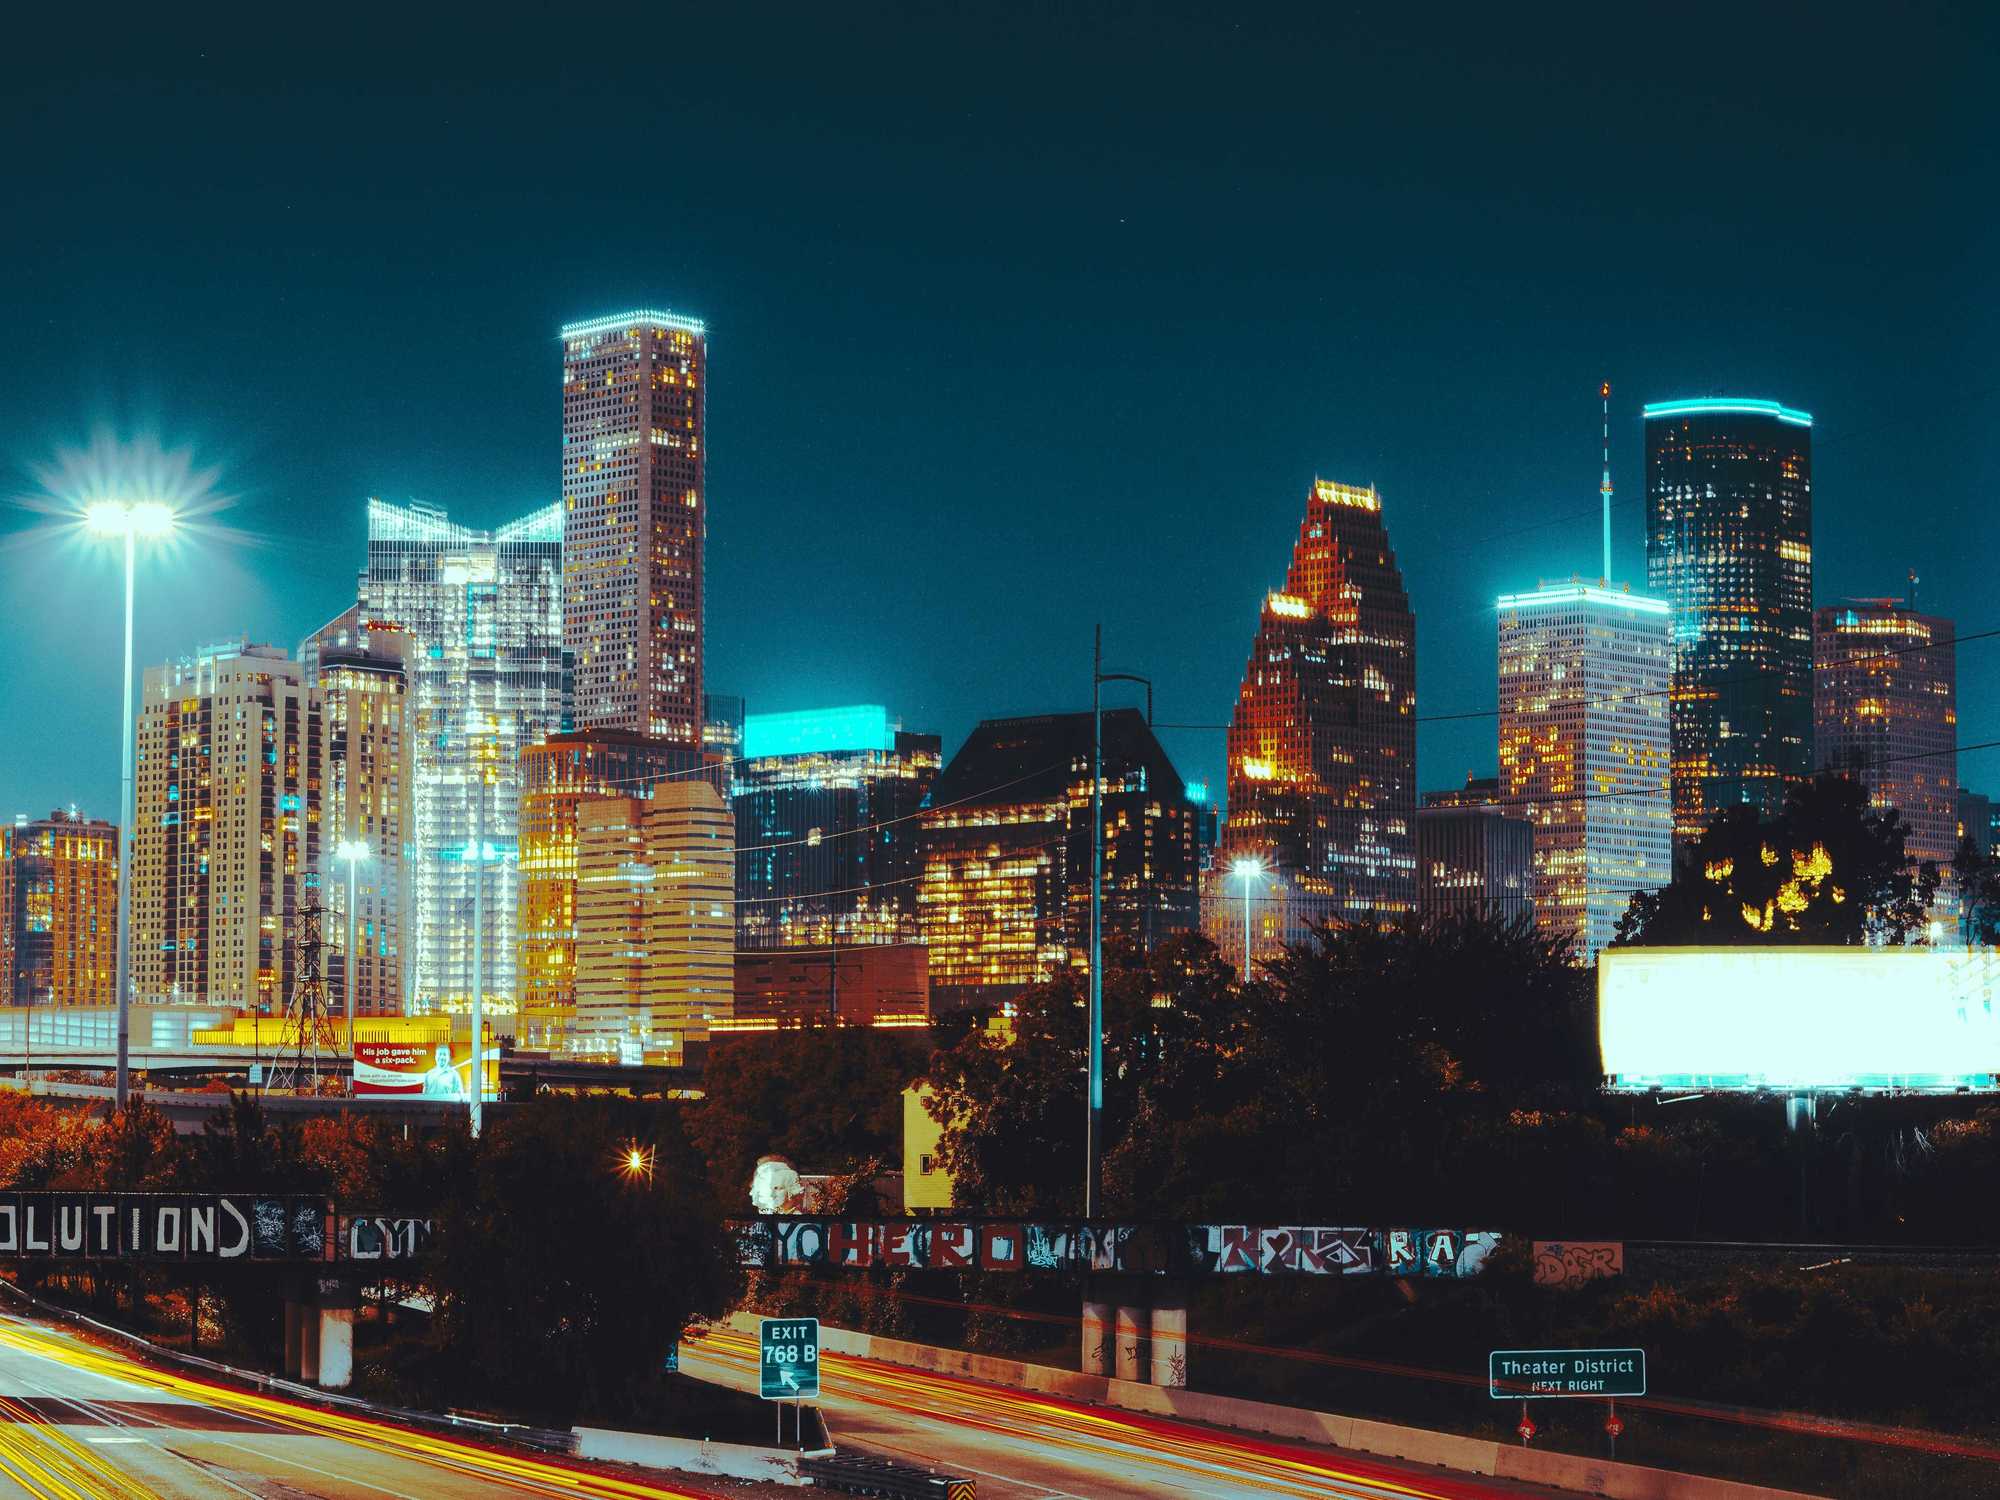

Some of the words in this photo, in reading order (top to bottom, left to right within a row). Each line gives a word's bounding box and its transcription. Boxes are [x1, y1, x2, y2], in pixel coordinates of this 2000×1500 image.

[362, 1047, 375, 1055] His
[376, 1047, 390, 1056] job
[391, 1048, 410, 1056] gave
[412, 1047, 427, 1055] him
[382, 1056, 417, 1065] six-pack.
[772, 1326, 808, 1340] EXIT
[763, 1344, 799, 1364] 768
[803, 1344, 816, 1363] B
[1502, 1360, 1566, 1375] Theater
[1574, 1358, 1634, 1374] District
[1531, 1380, 1563, 1393] NEXT
[1568, 1380, 1605, 1391] RIGHT
